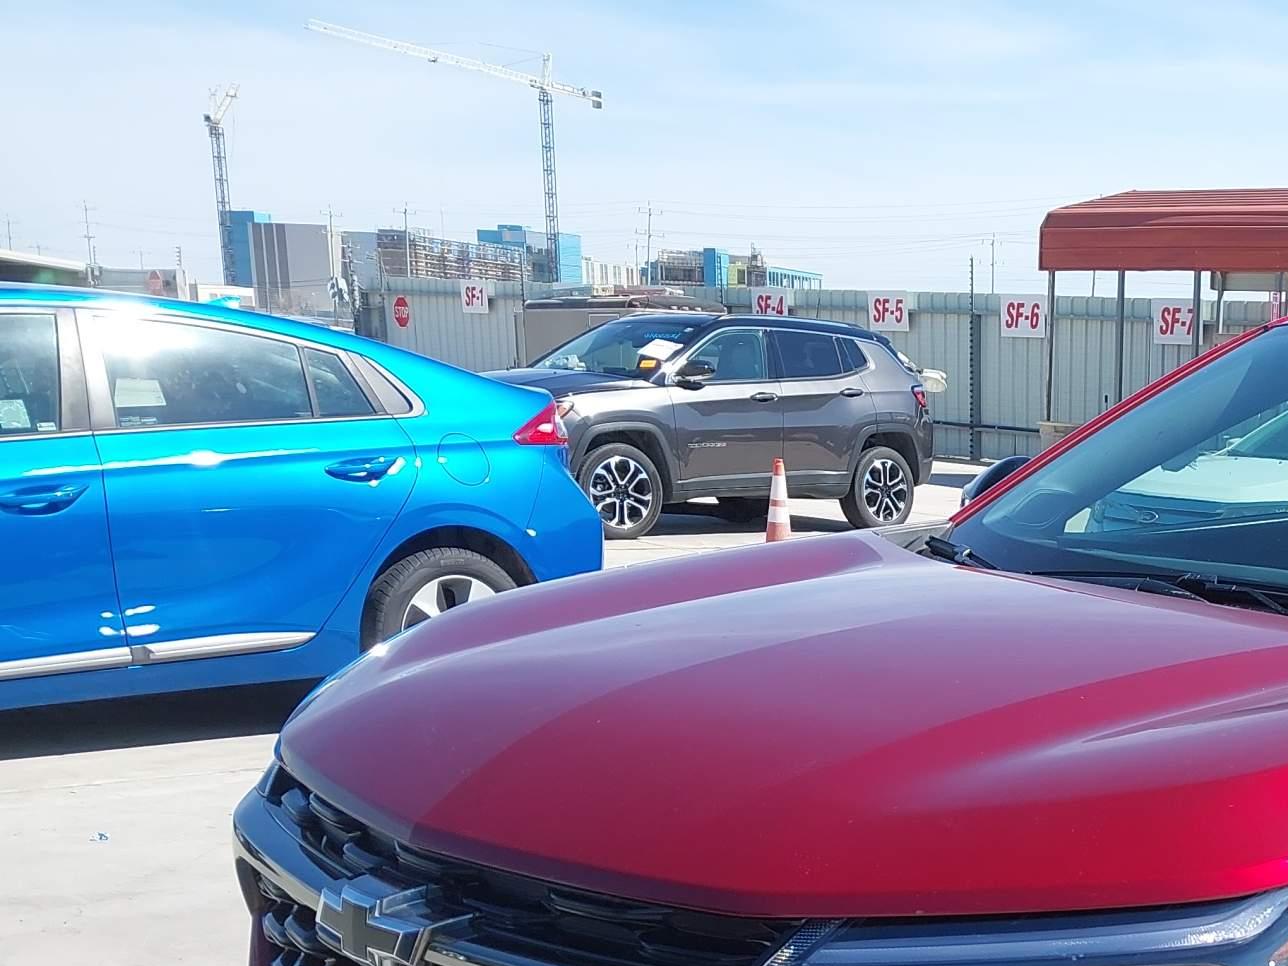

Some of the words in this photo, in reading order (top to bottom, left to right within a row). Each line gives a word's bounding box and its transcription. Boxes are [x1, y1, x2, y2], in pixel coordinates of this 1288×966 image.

[464, 286, 484, 307] SF-1
[756, 294, 784, 315] SF-4
[394, 306, 410, 318] STOP
[873, 297, 904, 323] SF-5
[1005, 302, 1041, 329] SF-6
